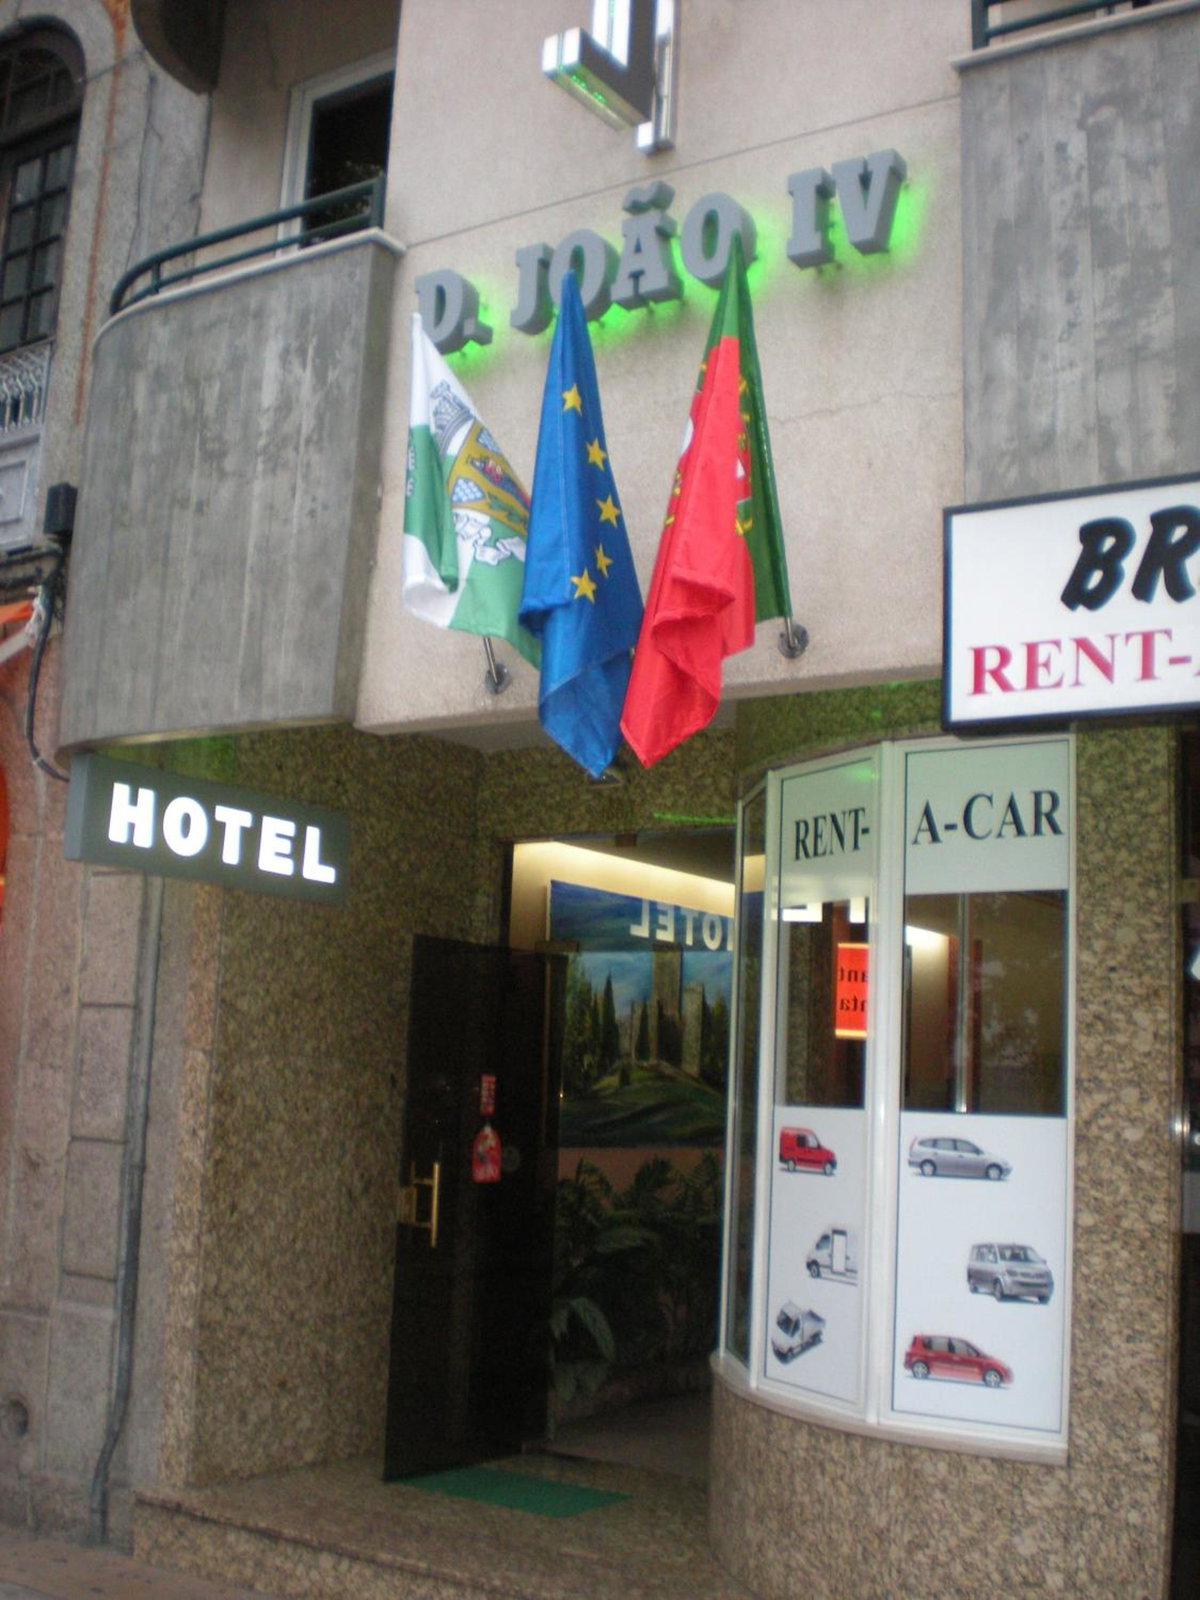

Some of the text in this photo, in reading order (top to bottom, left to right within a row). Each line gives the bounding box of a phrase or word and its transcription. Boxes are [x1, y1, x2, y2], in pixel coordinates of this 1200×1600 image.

[510, 181, 758, 335] JOÃO
[788, 149, 906, 269] IV
[967, 628, 1200, 697] RENT-
[108, 782, 336, 884] HOTEL
[794, 789, 1064, 861] RENT- A-CAR
